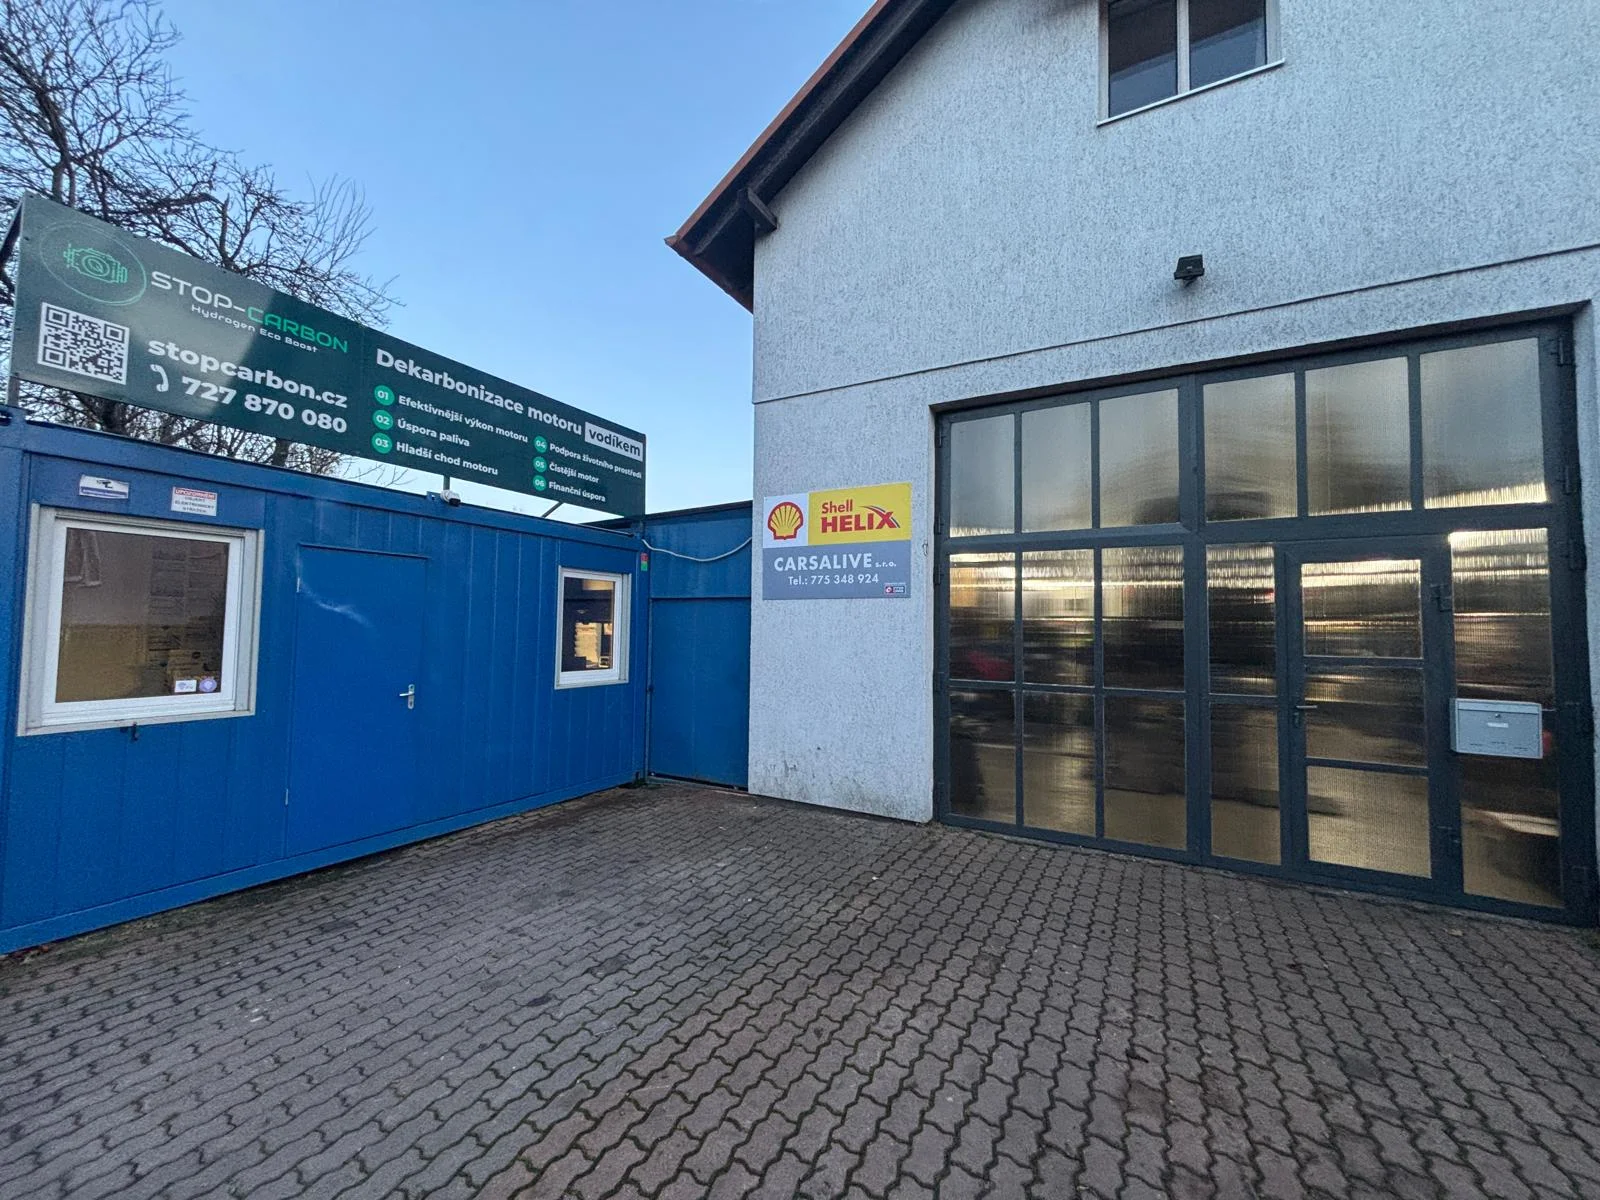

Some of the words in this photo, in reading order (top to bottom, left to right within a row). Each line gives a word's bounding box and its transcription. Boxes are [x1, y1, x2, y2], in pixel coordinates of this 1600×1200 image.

[151, 270, 348, 353] STOP-CARBON
[191, 304, 256, 333] Hydrogen
[259, 327, 282, 342] Eco
[285, 335, 318, 353] Boost
[147, 338, 348, 408] stopcarbon.cz
[181, 375, 236, 405] 727
[244, 393, 295, 420] 870
[301, 408, 347, 433] 080
[376, 348, 524, 414] Dekarbonizace
[527, 405, 582, 436] motoru
[588, 429, 640, 457] vodíkem
[377, 390, 389, 400] 01
[398, 395, 463, 422] Efektivnější
[464, 417, 494, 432] výkon
[495, 427, 529, 443] motoru
[376, 415, 390, 425] 02
[397, 418, 437, 438] Úspora
[439, 432, 470, 447] paliva
[375, 438, 389, 448] 03
[396, 442, 433, 459] Hladší
[434, 452, 460, 466] chod
[462, 461, 499, 476] motoru
[535, 440, 546, 449] 04
[549, 443, 581, 460] Podpora
[582, 454, 614, 470] životního
[614, 464, 642, 479] prostředí
[549, 462, 577, 478] Čistější
[577, 471, 600, 483] motor
[534, 479, 545, 487] 06
[548, 481, 581, 496] Finanční
[582, 489, 606, 502] úspora
[821, 499, 853, 514] Shell
[821, 510, 898, 534] HELIX
[774, 553, 872, 572] CARSALIVE
[875, 560, 897, 568] s.r.o.
[788, 575, 808, 586] Tel.:
[810, 575, 831, 585] 775
[833, 574, 855, 585] 348
[857, 573, 879, 584] 924
